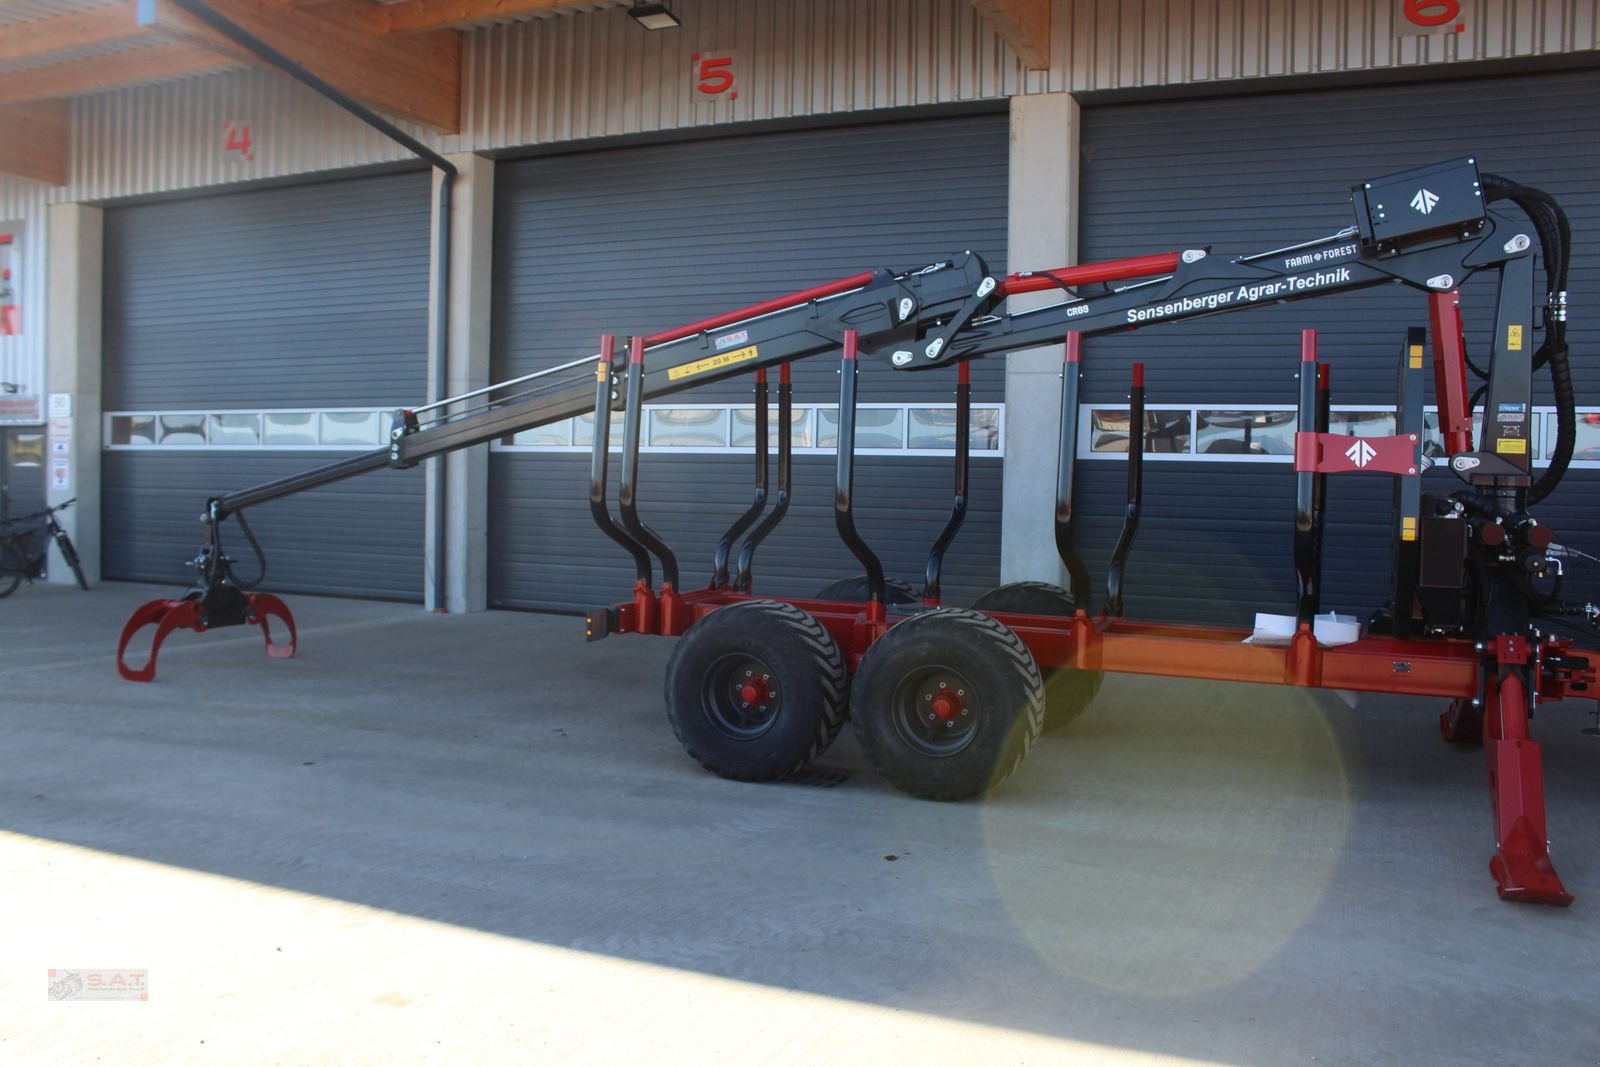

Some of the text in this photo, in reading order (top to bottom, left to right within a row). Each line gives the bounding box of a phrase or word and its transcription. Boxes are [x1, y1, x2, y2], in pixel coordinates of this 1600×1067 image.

[698, 57, 733, 94] 5
[225, 126, 251, 154] 4
[1285, 244, 1357, 269] FARMI FOREST
[1127, 268, 1350, 322] Sensenberger Agrar-Technik
